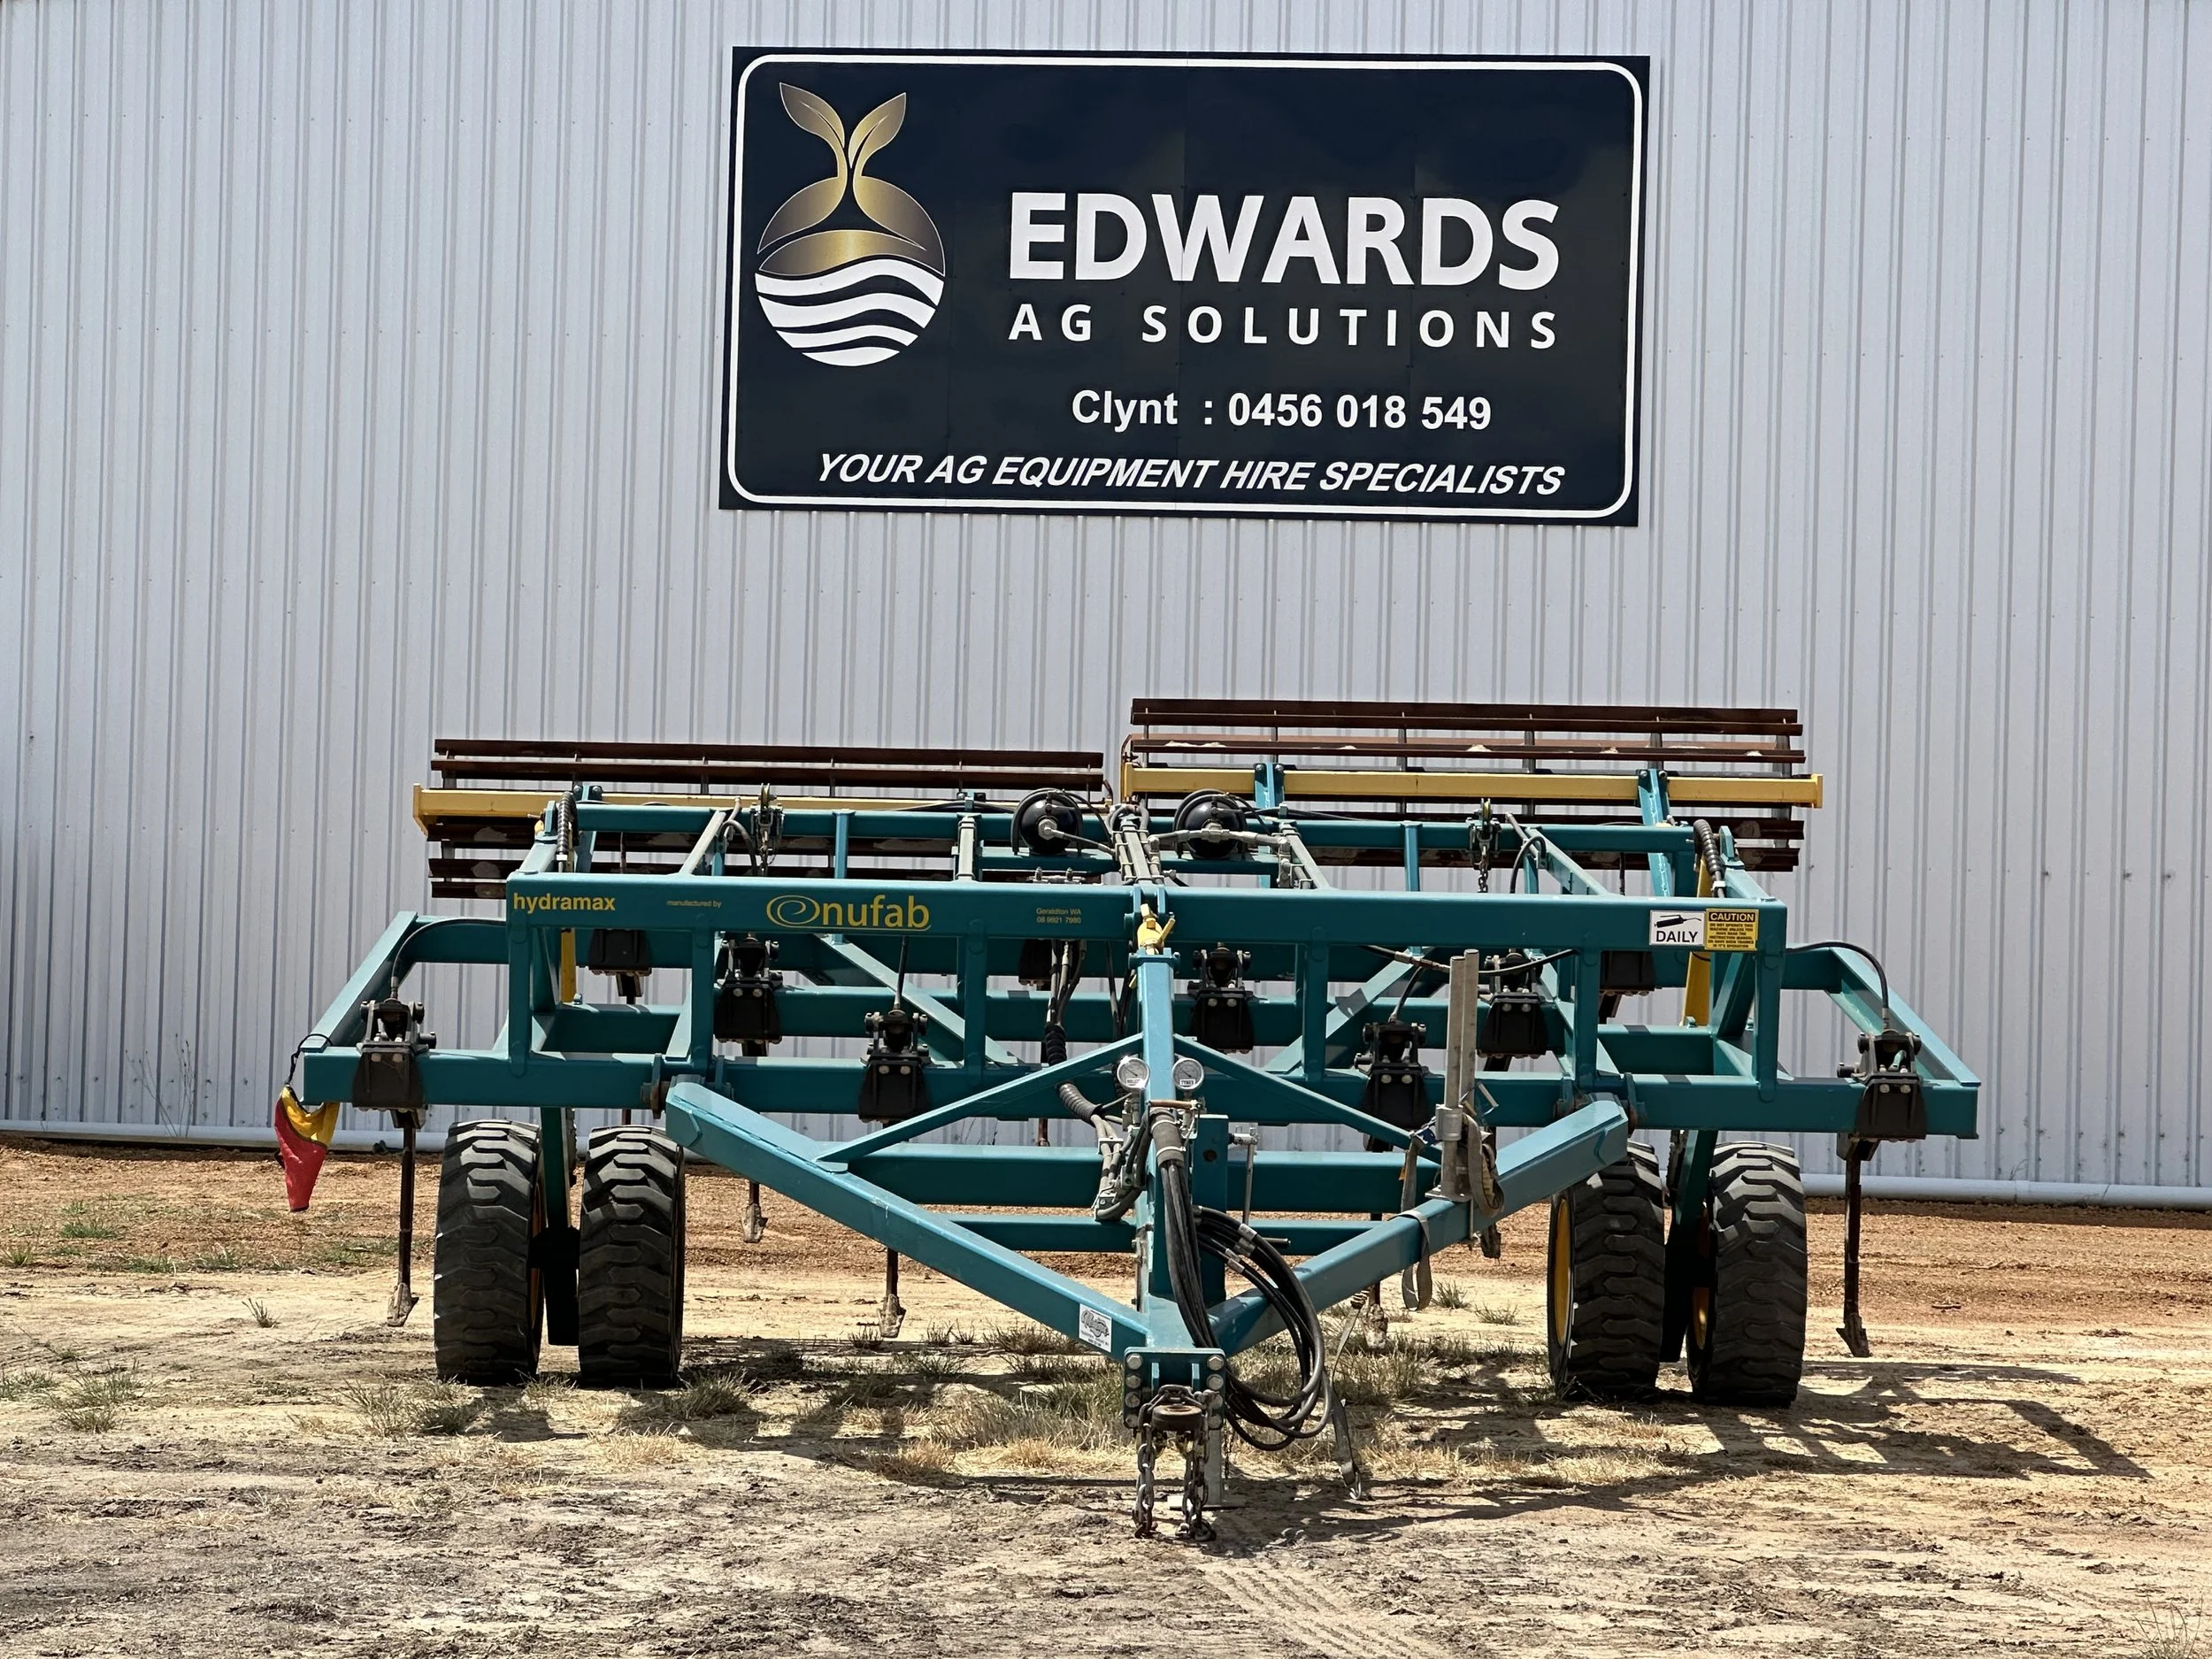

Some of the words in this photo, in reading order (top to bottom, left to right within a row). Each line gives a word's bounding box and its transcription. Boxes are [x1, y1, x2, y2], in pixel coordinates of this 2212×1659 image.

[1010, 192, 1559, 290] EDWARDS
[1009, 303, 1092, 342] AG
[1142, 305, 1555, 349] SOLUTIONS
[1072, 389, 1179, 433] Clynt
[1228, 393, 1323, 427] 0456
[1337, 394, 1407, 429] 018
[1421, 396, 1492, 430] 549
[819, 454, 924, 483] YOUR
[925, 456, 987, 484] AG
[992, 457, 1220, 488] EQUIPMENT
[1220, 461, 1317, 490] HIRE
[1320, 462, 1566, 495] SPECIALISTS
[513, 892, 616, 914] hydramax
[712, 900, 723, 910] by
[822, 894, 930, 928] nufab
[1710, 912, 1755, 922] CAUTION
[1656, 931, 1698, 943] DAILY
